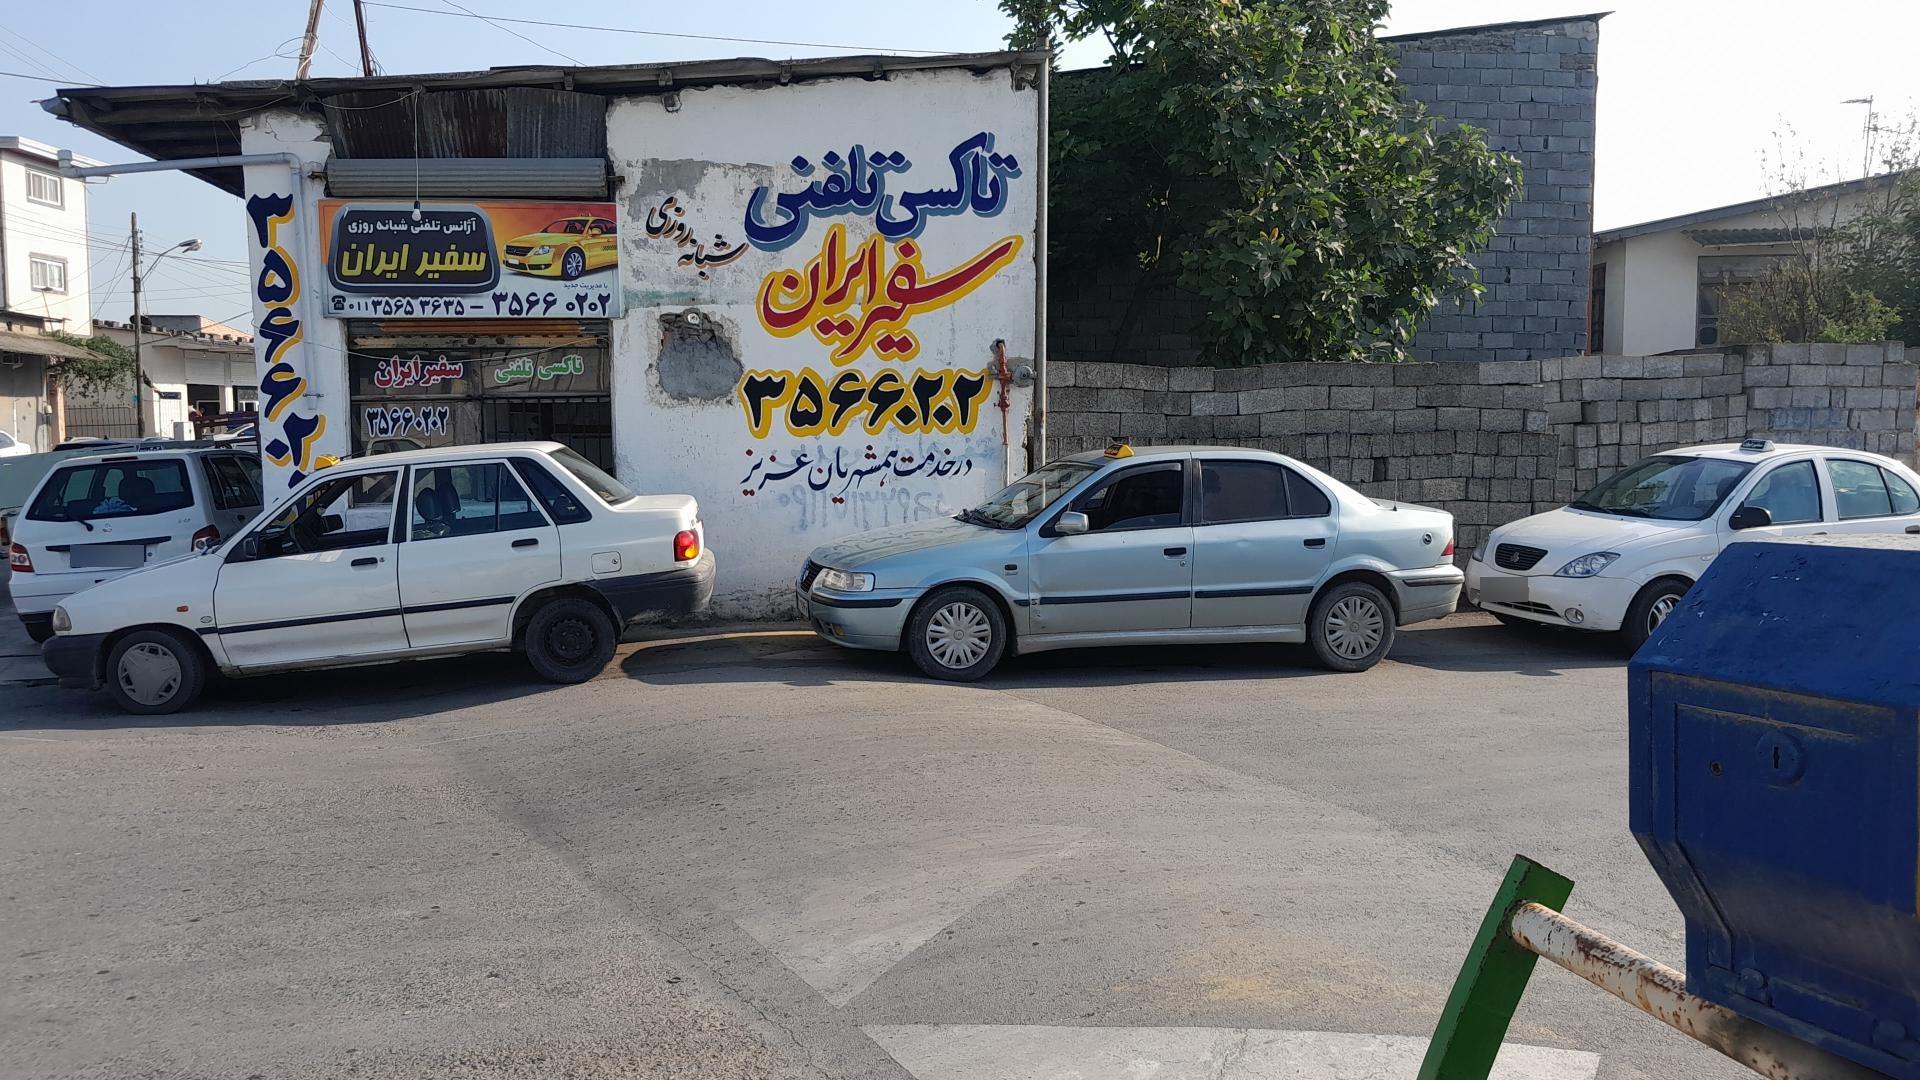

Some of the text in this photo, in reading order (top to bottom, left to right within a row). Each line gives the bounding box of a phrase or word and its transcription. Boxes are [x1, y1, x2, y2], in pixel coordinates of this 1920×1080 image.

[745, 132, 1020, 252] تاکسی تلفنی
[347, 217, 477, 235] آژانس تلفنی شبانه روزی
[646, 196, 749, 280] شبانه روزی
[341, 243, 487, 279] سفیر ایران
[757, 224, 1021, 364] سفیر ایران
[374, 354, 464, 389] سفیر ایران
[494, 354, 584, 383] تاکسی تلفنی
[365, 406, 450, 438] ۳۵۶۶۰۲۰۲
[740, 369, 990, 437] ۳۵۶۶۰۲۰۲
[740, 448, 814, 497] عزیز
